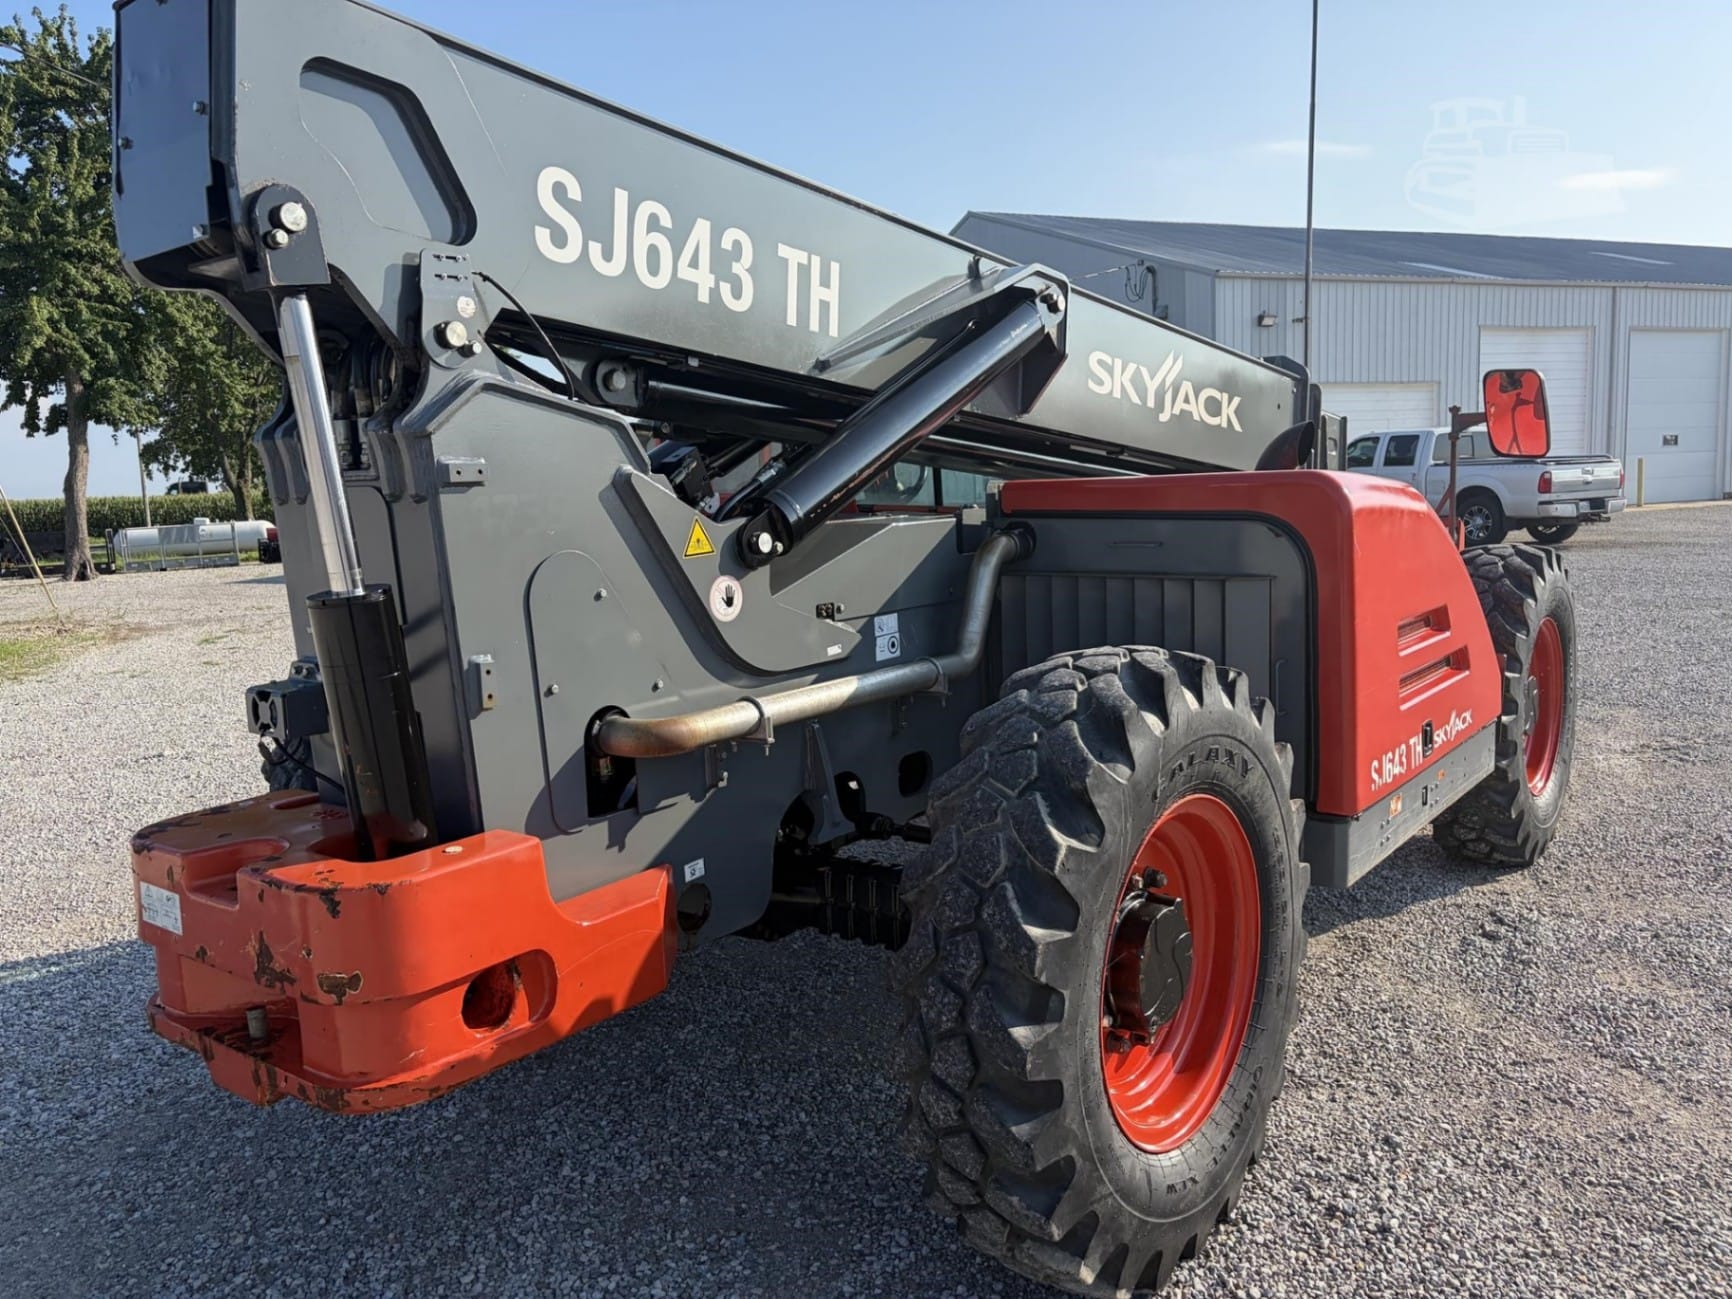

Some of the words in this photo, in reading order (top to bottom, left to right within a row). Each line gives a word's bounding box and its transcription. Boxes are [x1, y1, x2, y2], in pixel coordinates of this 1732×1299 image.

[534, 165, 754, 313] SJ643
[777, 242, 840, 338] TH
[1087, 349, 1243, 433] SKYJACK
[1371, 743, 1407, 792] SJ643
[1409, 733, 1423, 770] TH
[1433, 708, 1473, 749] SKYJACK
